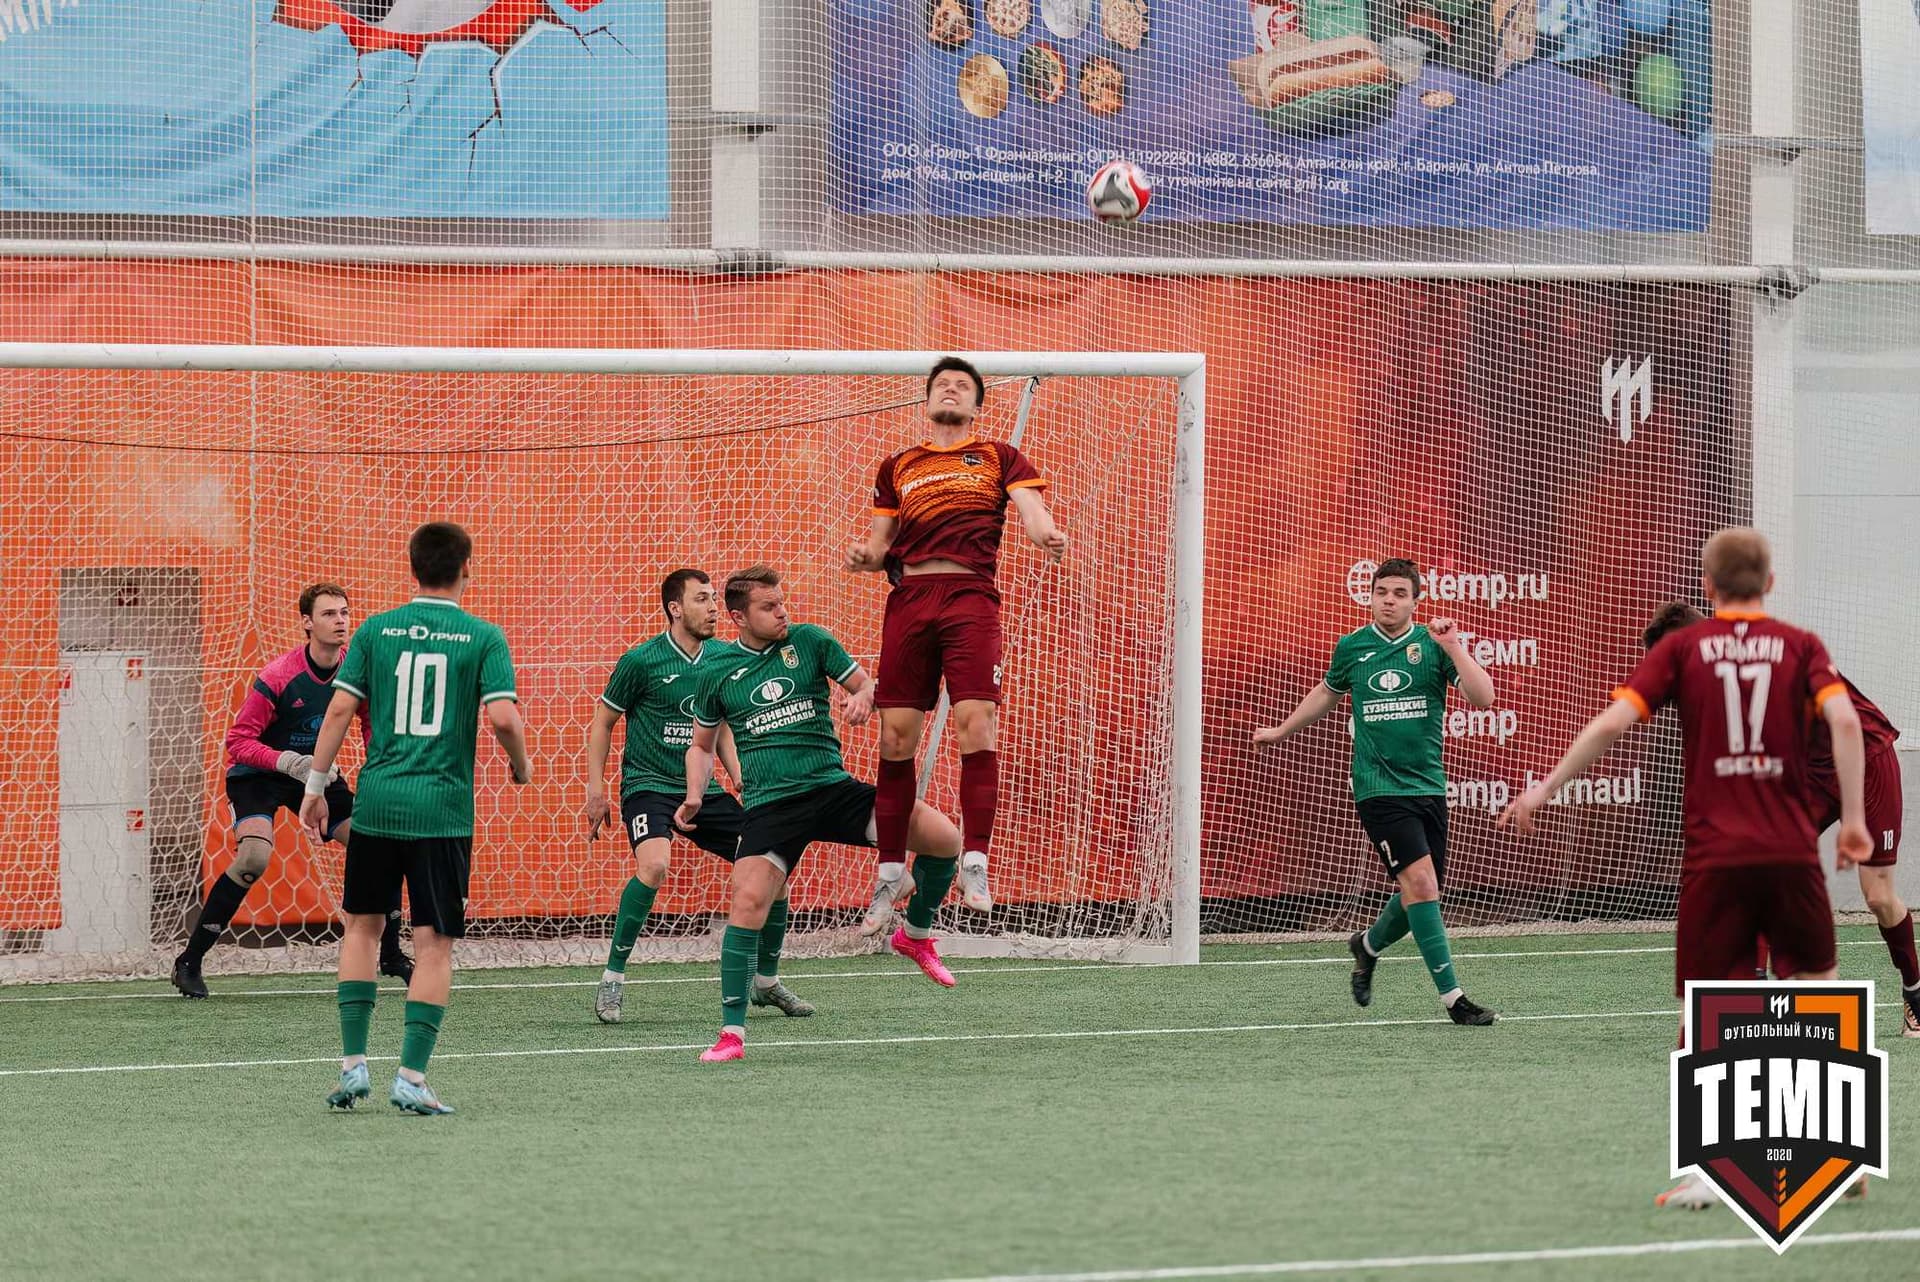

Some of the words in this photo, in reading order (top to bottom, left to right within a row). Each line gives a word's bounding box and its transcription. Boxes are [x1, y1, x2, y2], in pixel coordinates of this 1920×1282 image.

[883, 144, 920, 158] ООО
[1087, 150, 1124, 162] ОГРН
[1496, 160, 1541, 174] Антона
[882, 167, 911, 181] дом
[954, 169, 1034, 183] помещение
[1168, 174, 1234, 188] уточняйте
[1237, 176, 1252, 187] на
[1256, 174, 1291, 188] сайте
[395, 651, 447, 736] 10
[746, 700, 813, 730] КУЗНЕЦКИЕ
[1363, 700, 1428, 714] КУЗНЕЦКИЕ
[1714, 661, 1772, 754] 17
[664, 726, 693, 736] КУЗН
[664, 736, 693, 745] ФЕРРО
[632, 813, 649, 841] 18
[1882, 830, 1894, 850] 18
